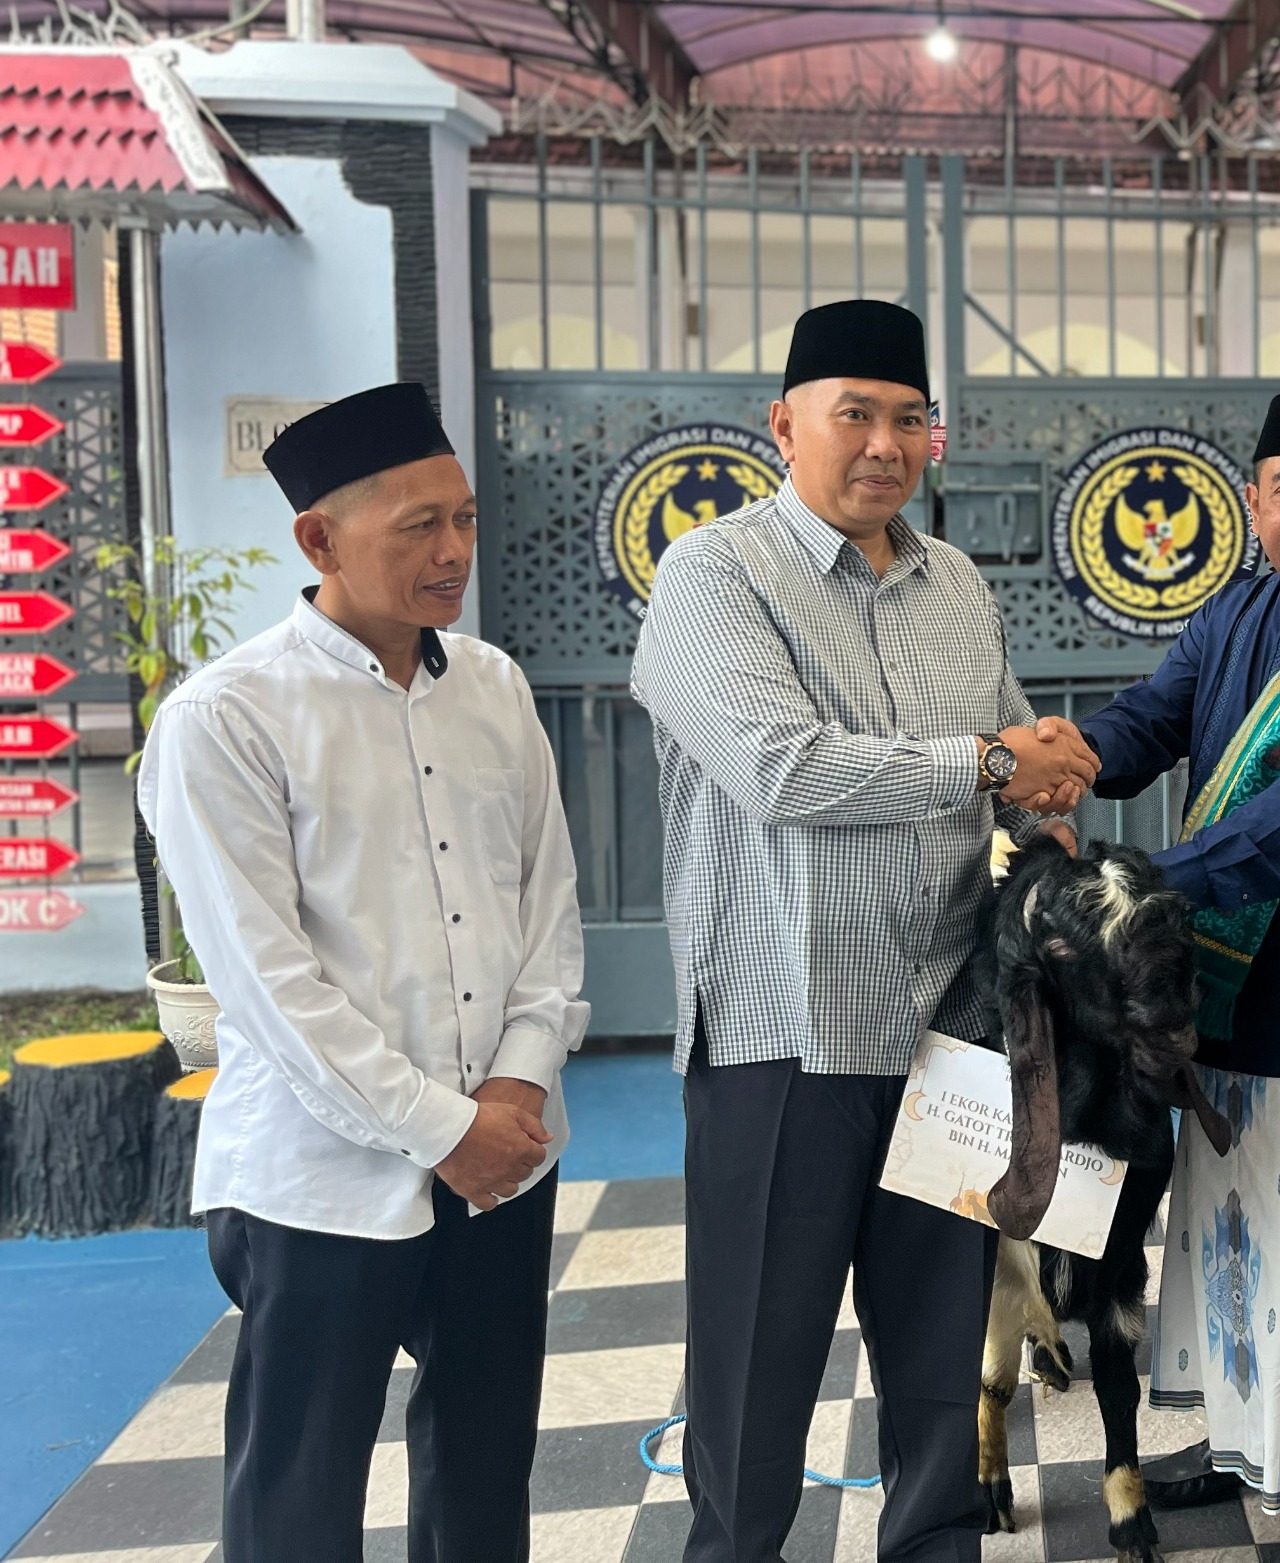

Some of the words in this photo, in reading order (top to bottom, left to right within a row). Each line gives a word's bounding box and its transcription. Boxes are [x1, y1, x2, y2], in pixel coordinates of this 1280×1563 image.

[237, 421, 294, 451] BL
[711, 427, 750, 449] DAN
[1053, 465, 1089, 580] KEMENTERIAN
[1086, 430, 1156, 468] IMIGRASI
[1158, 430, 1196, 450] DAN
[1083, 595, 1155, 636] REPUBLIK
[38, 899, 58, 924] C
[949, 1093, 990, 1118] EKOR
[926, 1103, 941, 1118] H.
[944, 1109, 995, 1136] GATOT
[1061, 1149, 1104, 1172] RDJO
[948, 1128, 976, 1148] BIN
[977, 1138, 992, 1154] H.
